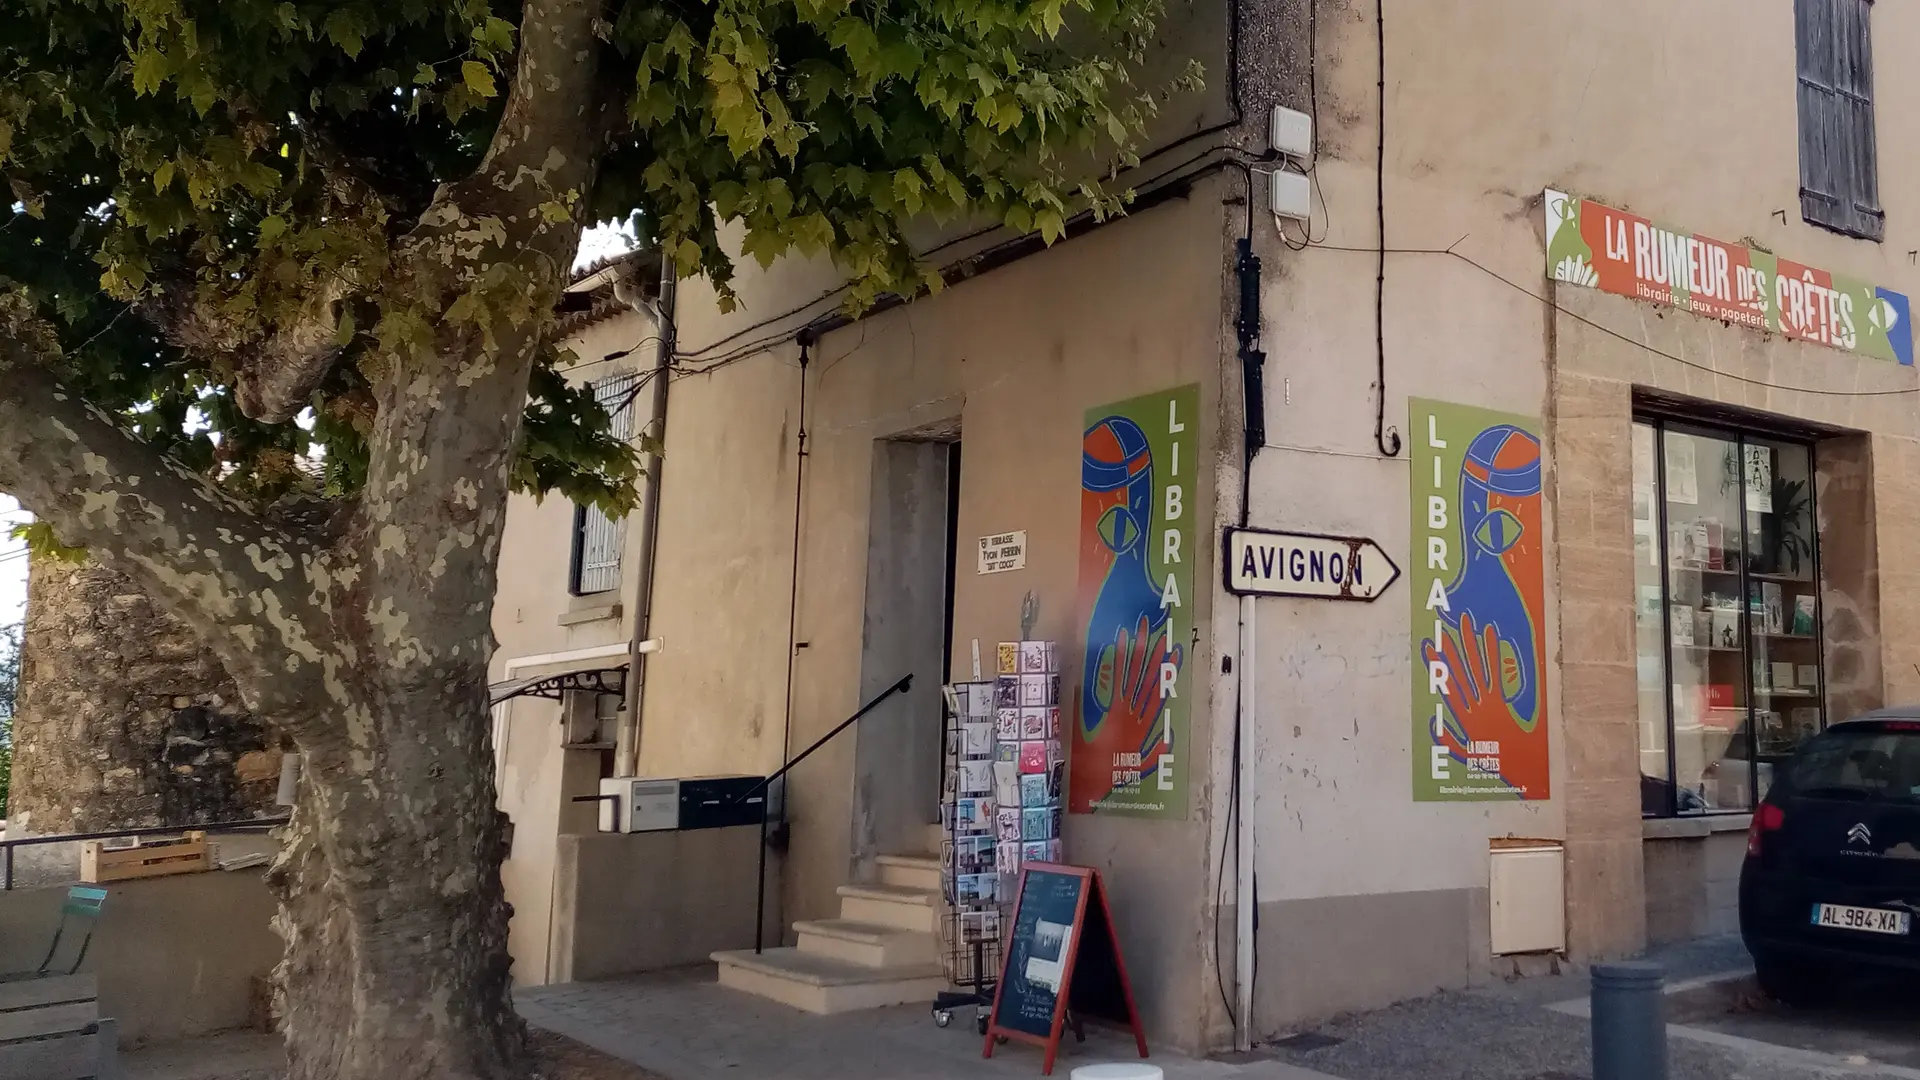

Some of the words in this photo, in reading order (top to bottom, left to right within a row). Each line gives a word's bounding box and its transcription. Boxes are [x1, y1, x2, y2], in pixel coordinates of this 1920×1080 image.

[1605, 215, 1629, 263] LA
[1634, 221, 1731, 302] RUMEUR
[1736, 264, 1769, 312] DES
[1775, 269, 1856, 349] CRÊTES
[1636, 282, 1680, 305] librairie
[1688, 295, 1712, 314] jeux
[1720, 306, 1770, 328] papeterie
[1157, 400, 1185, 791] LIBRAIRIE
[1241, 544, 1363, 586] AVIGNON
[1425, 414, 1451, 780] LIBRAIRIE
[1113, 752, 1120, 767] LA
